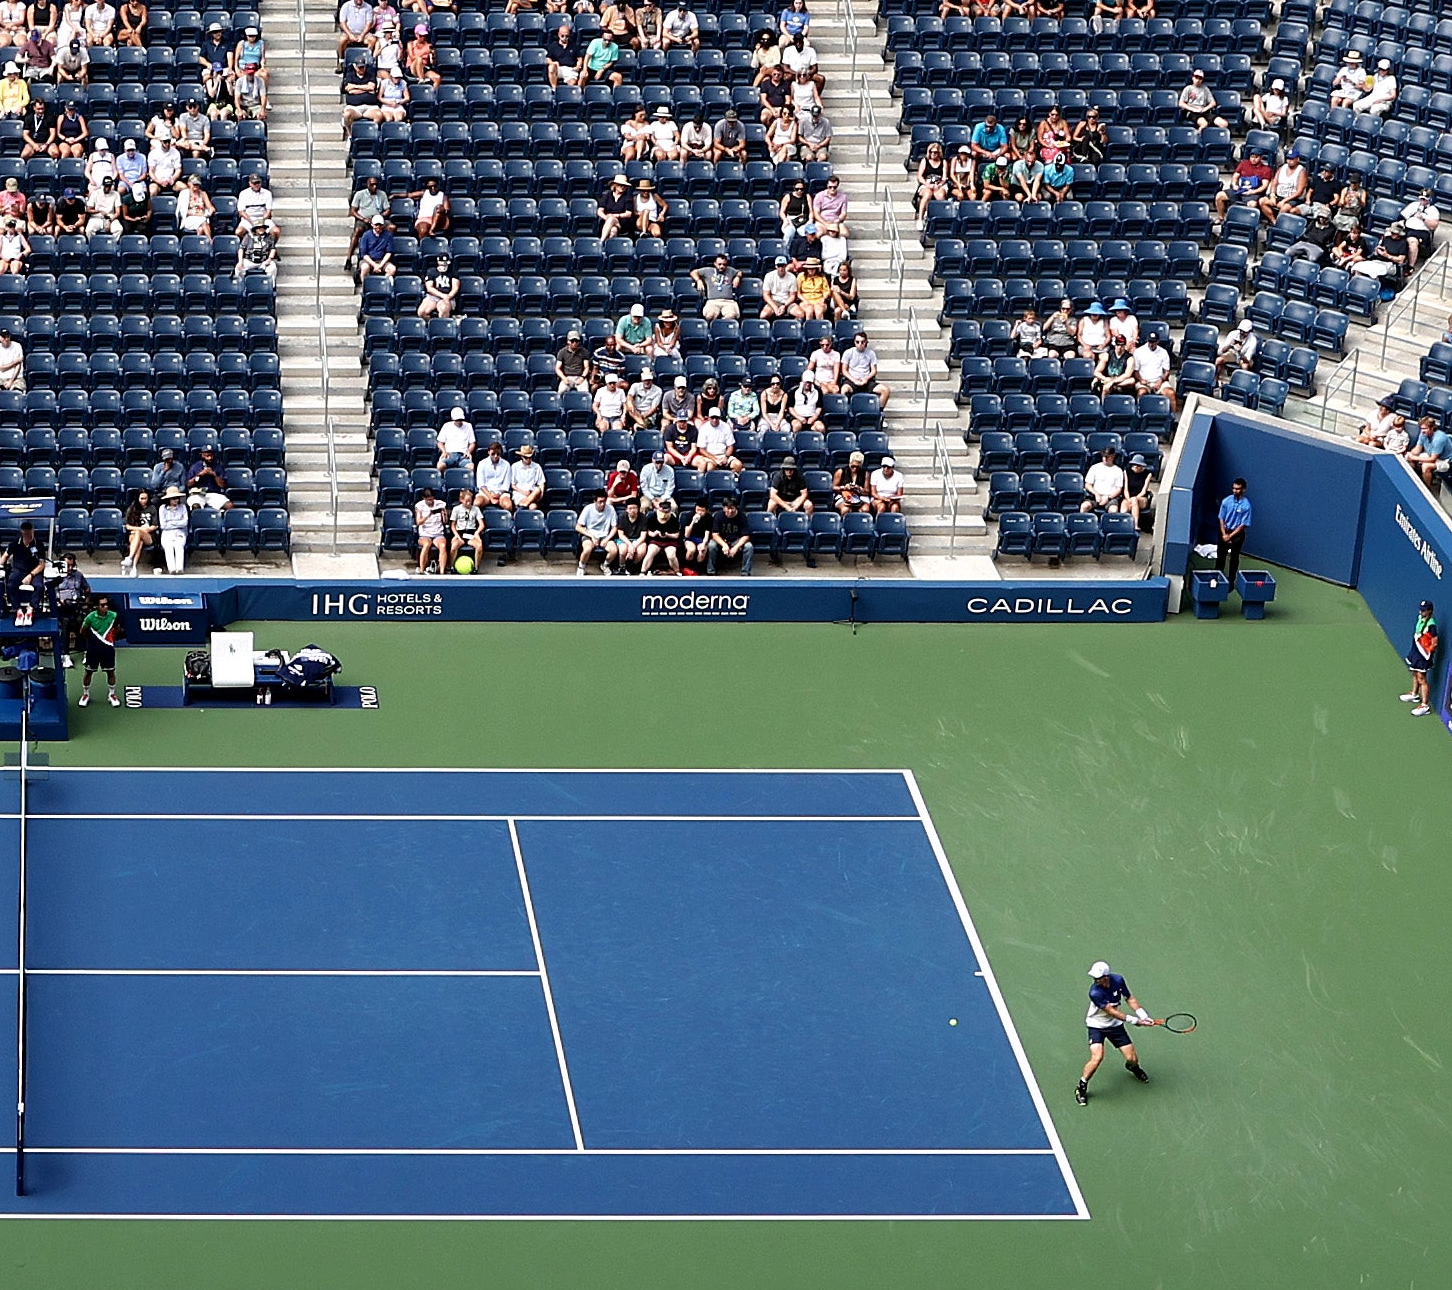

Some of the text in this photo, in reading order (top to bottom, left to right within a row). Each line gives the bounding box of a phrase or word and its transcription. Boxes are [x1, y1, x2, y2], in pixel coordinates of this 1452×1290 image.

[312, 593, 370, 615] IHG
[377, 593, 443, 603] HOTELS &
[641, 591, 748, 610] moderna
[967, 597, 1133, 614] CADILLAC
[376, 605, 443, 615] RESORTS
[139, 617, 192, 631] Wilson
[125, 686, 143, 708] POLO
[359, 687, 379, 709] POLO
